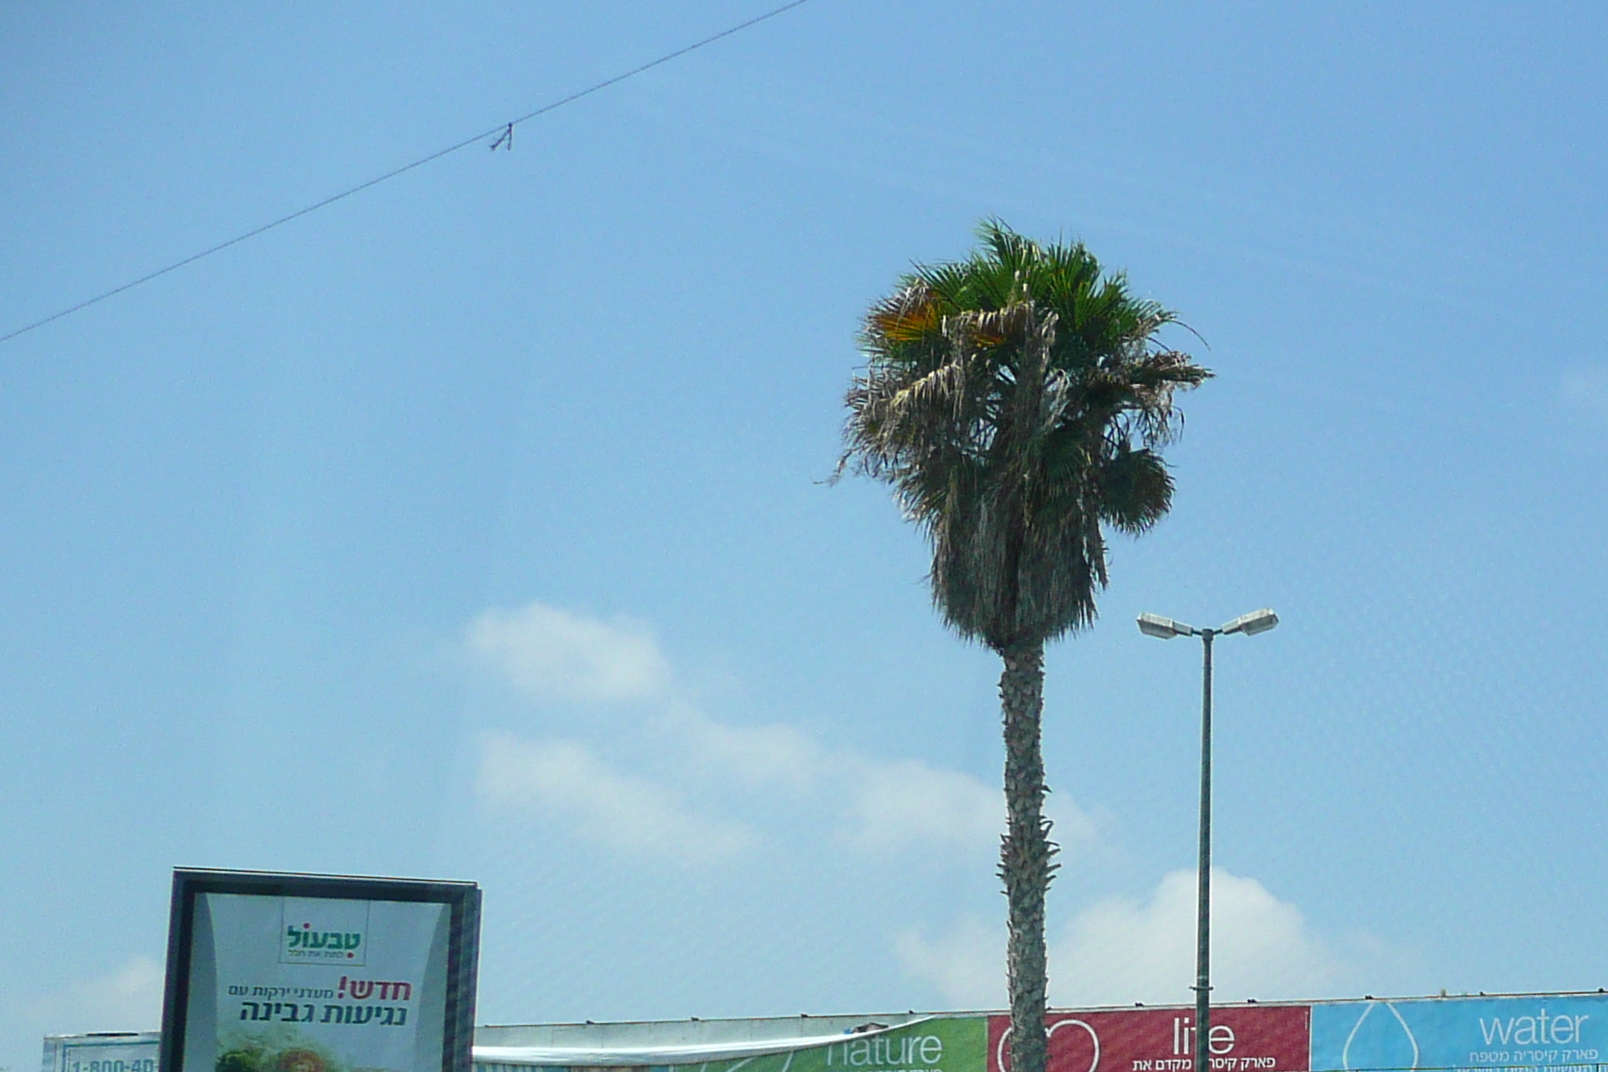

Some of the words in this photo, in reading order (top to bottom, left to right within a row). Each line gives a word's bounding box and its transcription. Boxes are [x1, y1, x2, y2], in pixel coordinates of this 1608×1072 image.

[228, 985, 249, 996] עם
[252, 986, 290, 1001] ירקות
[293, 987, 334, 999] מעדני
[338, 976, 412, 1000] חדש!
[240, 1001, 315, 1023] גבינה
[320, 1005, 408, 1026] נגיעות
[1479, 1008, 1589, 1045] water
[1174, 1017, 1235, 1055] lie
[827, 1035, 942, 1066] nature
[1470, 1051, 1510, 1063] מטפח
[1514, 1050, 1557, 1062] קיסריה
[1562, 1049, 1599, 1062] פארק
[1133, 1060, 1152, 1071] את
[1155, 1059, 1192, 1072] מקדם
[1241, 1057, 1276, 1071] פארק
